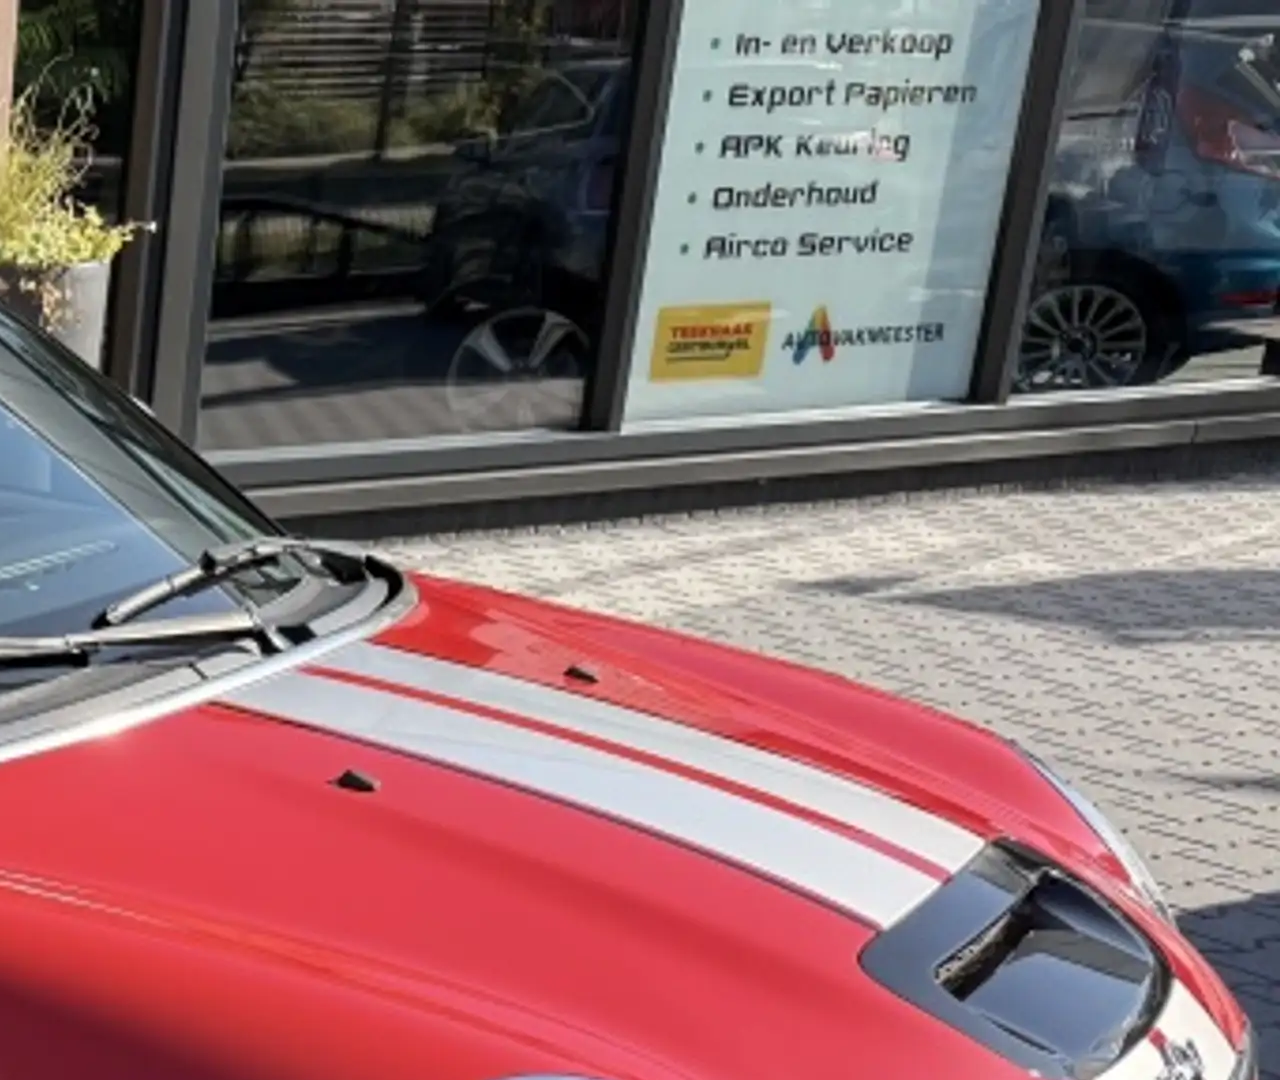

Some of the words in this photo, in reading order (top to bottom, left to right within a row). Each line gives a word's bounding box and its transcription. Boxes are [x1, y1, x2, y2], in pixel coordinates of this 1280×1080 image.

[736, 33, 771, 55] In-
[781, 33, 817, 54] en
[826, 29, 953, 60] Verkoop
[728, 80, 835, 113] Export
[844, 79, 977, 111] Papieren
[718, 135, 783, 158] APK
[795, 128, 910, 161] Keuring
[713, 181, 878, 210] Onderhoud
[704, 233, 788, 259] Airco
[797, 228, 914, 256] Service
